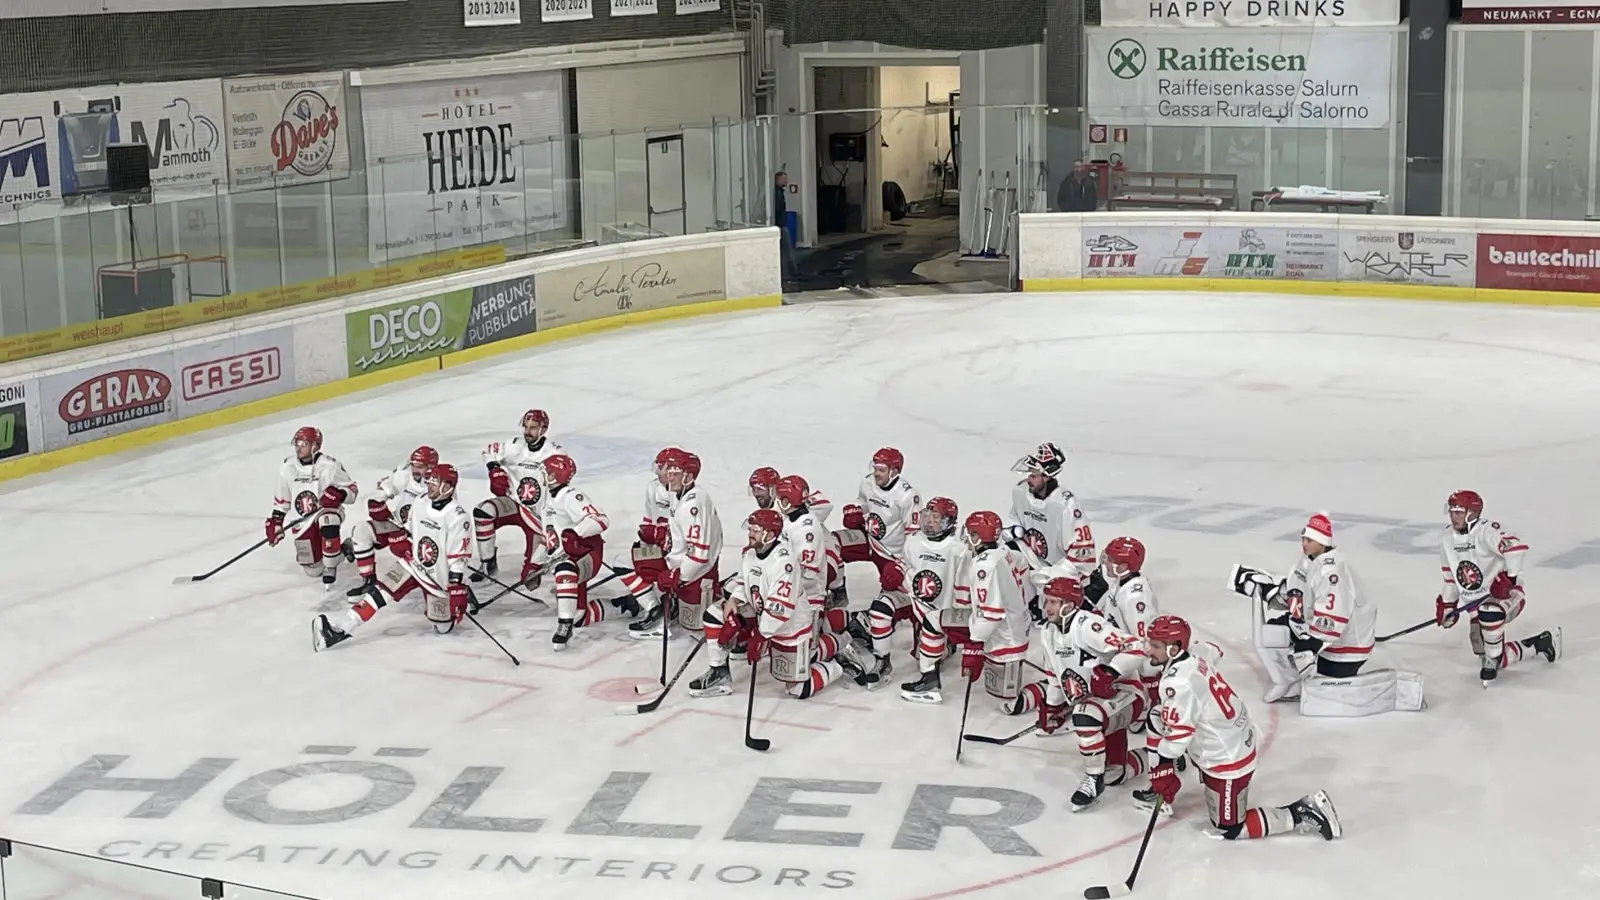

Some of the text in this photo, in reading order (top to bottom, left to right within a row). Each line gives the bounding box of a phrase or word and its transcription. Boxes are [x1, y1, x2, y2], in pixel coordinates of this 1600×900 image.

[1149, 0, 1345, 18] HAPPY DRINKS
[1483, 10, 1552, 20] NEUMARKT
[1157, 47, 1307, 72] Raiffeisen
[1158, 79, 1359, 97] Raiffeisenkasse Salurn
[441, 103, 496, 120] HOTEL
[1158, 100, 1211, 118] Cassa
[1217, 100, 1272, 118] Rurale
[1300, 101, 1369, 119] Salorno
[271, 106, 338, 171] Dave's
[422, 123, 516, 194] HEIDE
[447, 193, 500, 213] PARK
[1087, 254, 1138, 268] HTM
[1225, 254, 1276, 268] HTM
[202, 297, 249, 316] weishaupt
[469, 278, 532, 324] WERBUNG
[369, 301, 441, 349] DECO
[469, 293, 536, 344] PUBBLICITÀ
[72, 321, 124, 342] weishaupt
[355, 336, 455, 369] service
[190, 356, 273, 394] FASSI
[66, 373, 162, 417] GERAX
[68, 402, 165, 433] GRU-PIATTAFORME
[687, 524, 701, 539] 13
[777, 580, 793, 598] 25
[1325, 593, 1336, 611] 3
[13, 744, 1043, 857] HÖLLER
[99, 838, 857, 889] CREATING INTERIORS
